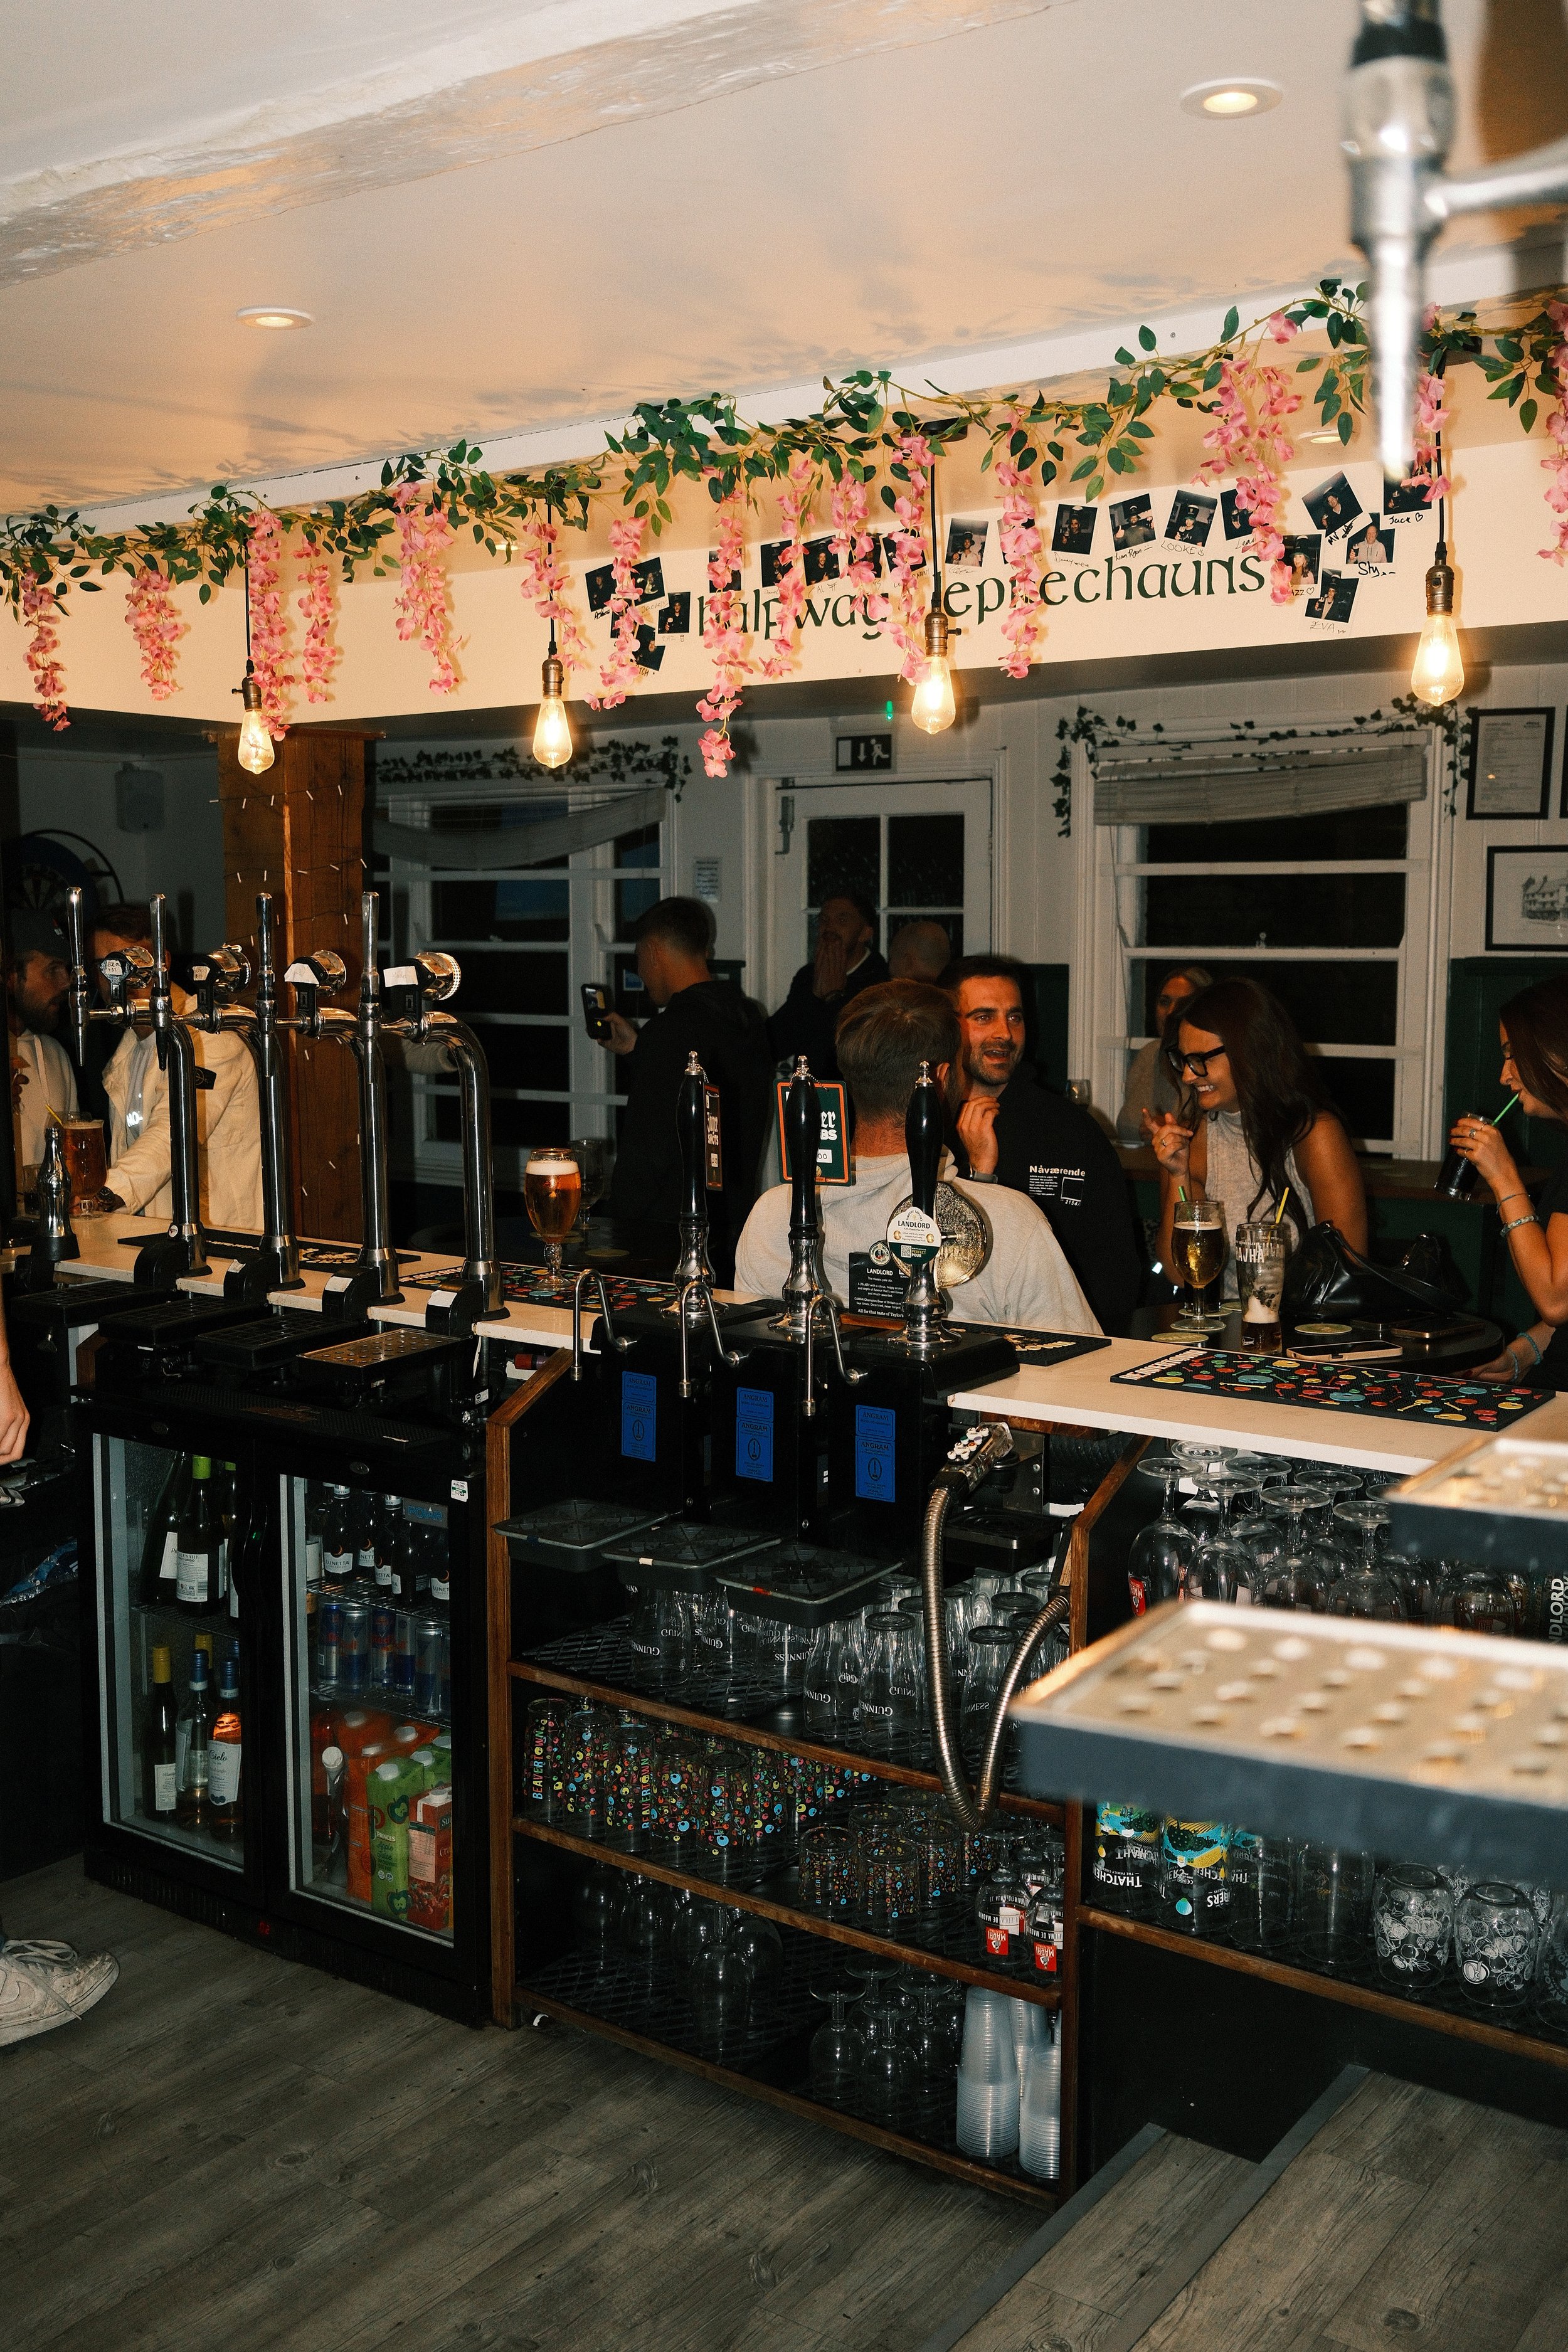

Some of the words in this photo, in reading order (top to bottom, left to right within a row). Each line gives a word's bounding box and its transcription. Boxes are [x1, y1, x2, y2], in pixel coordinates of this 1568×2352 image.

[1029, 1165, 1086, 1176] Nåværende
[898, 1221, 930, 1229] LANDLORD
[743, 1394, 768, 1402] ANGRAM
[627, 1404, 651, 1414] ANGRAM
[862, 1412, 889, 1421] ANGRAM
[741, 1422, 768, 1432] ANGRAM
[861, 1441, 889, 1451] ANGRAM
[775, 1651, 812, 1661] UINNESS
[209, 1749, 227, 1761] Cielo
[376, 1831, 396, 1842] PRINCES
[377, 1841, 394, 1851] Apple
[377, 1851, 393, 1861] Juice
